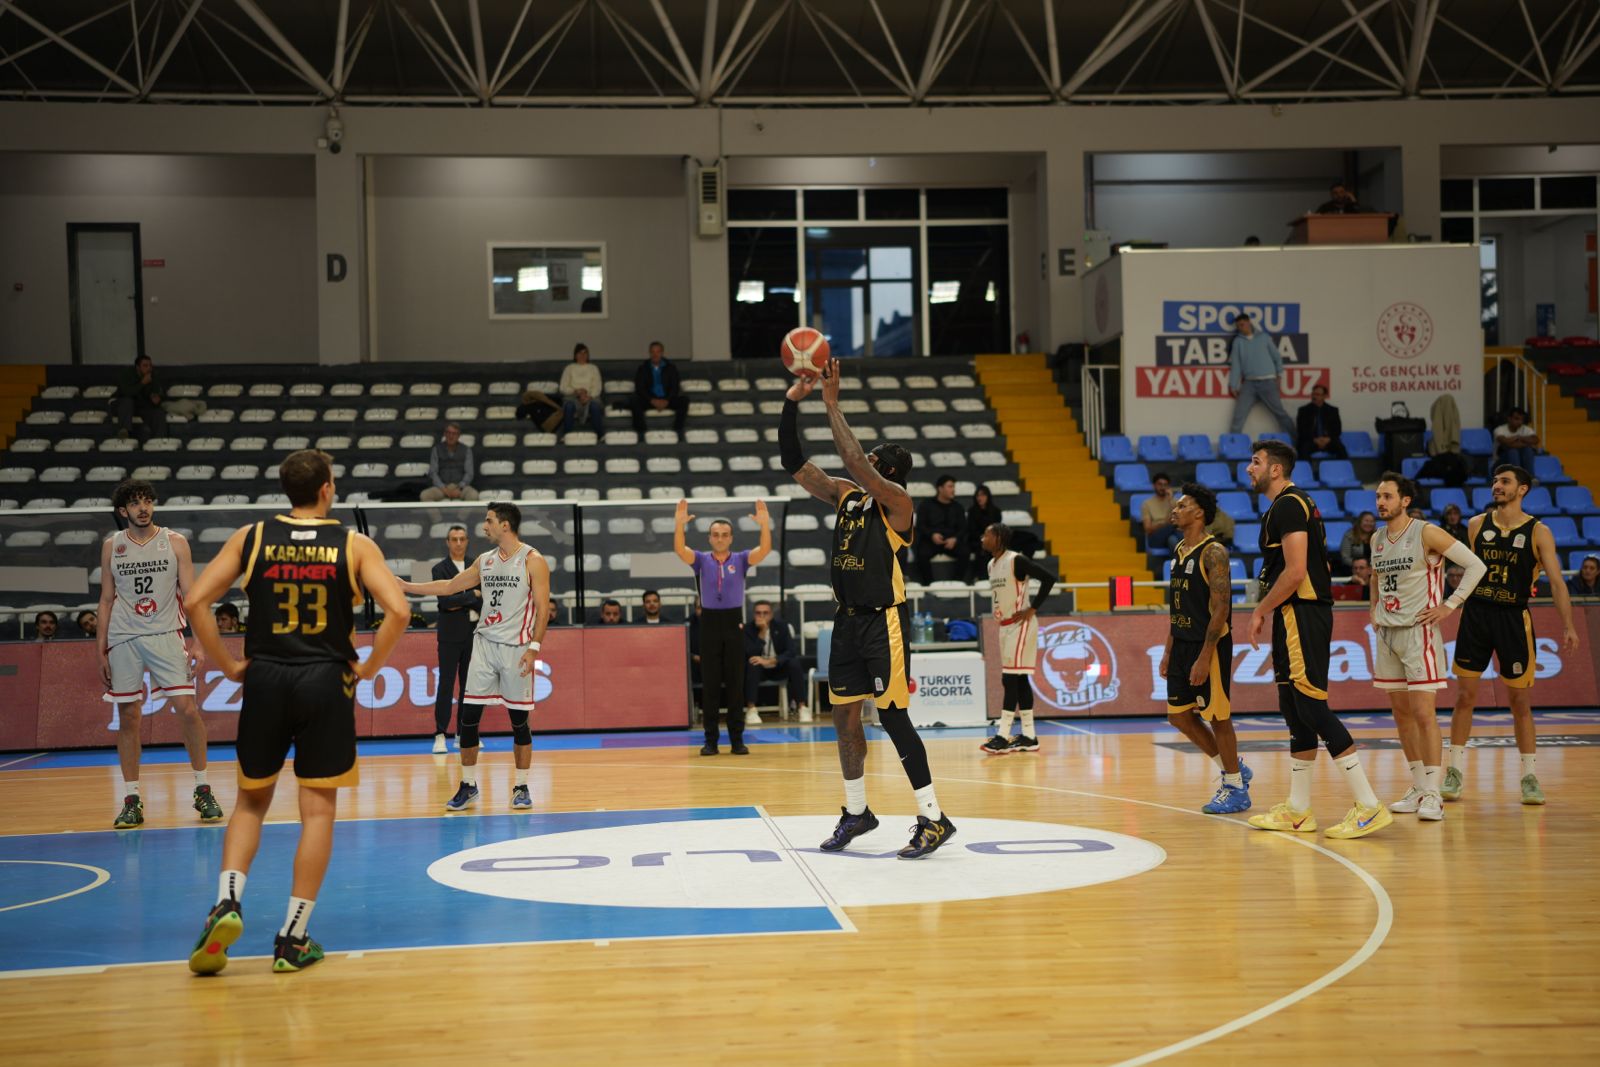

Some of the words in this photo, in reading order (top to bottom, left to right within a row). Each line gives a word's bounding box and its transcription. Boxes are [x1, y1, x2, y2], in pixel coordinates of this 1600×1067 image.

[327, 253, 347, 282] D
[1059, 249, 1076, 276] E
[1178, 304, 1285, 332] SPORU
[1166, 336, 1298, 364] TABA
[1352, 367, 1375, 377] T.C.
[1380, 364, 1439, 378] GENÇLİK
[1443, 364, 1461, 375] VE
[1144, 368, 1322, 395] YAYIYUZ
[1352, 382, 1387, 393] SPOR
[1390, 378, 1462, 391] BAKANLIĞI
[265, 545, 338, 563] KARAHAN
[1483, 549, 1518, 564] KONYA
[139, 566, 168, 575] OSMAN
[1386, 564, 1411, 573] OSMAN
[134, 576, 153, 595] 52
[1384, 574, 1398, 592] 35
[490, 590, 504, 607] 32
[272, 583, 327, 634] 33
[1037, 626, 1093, 649] izza
[1056, 683, 1117, 706] bulls
